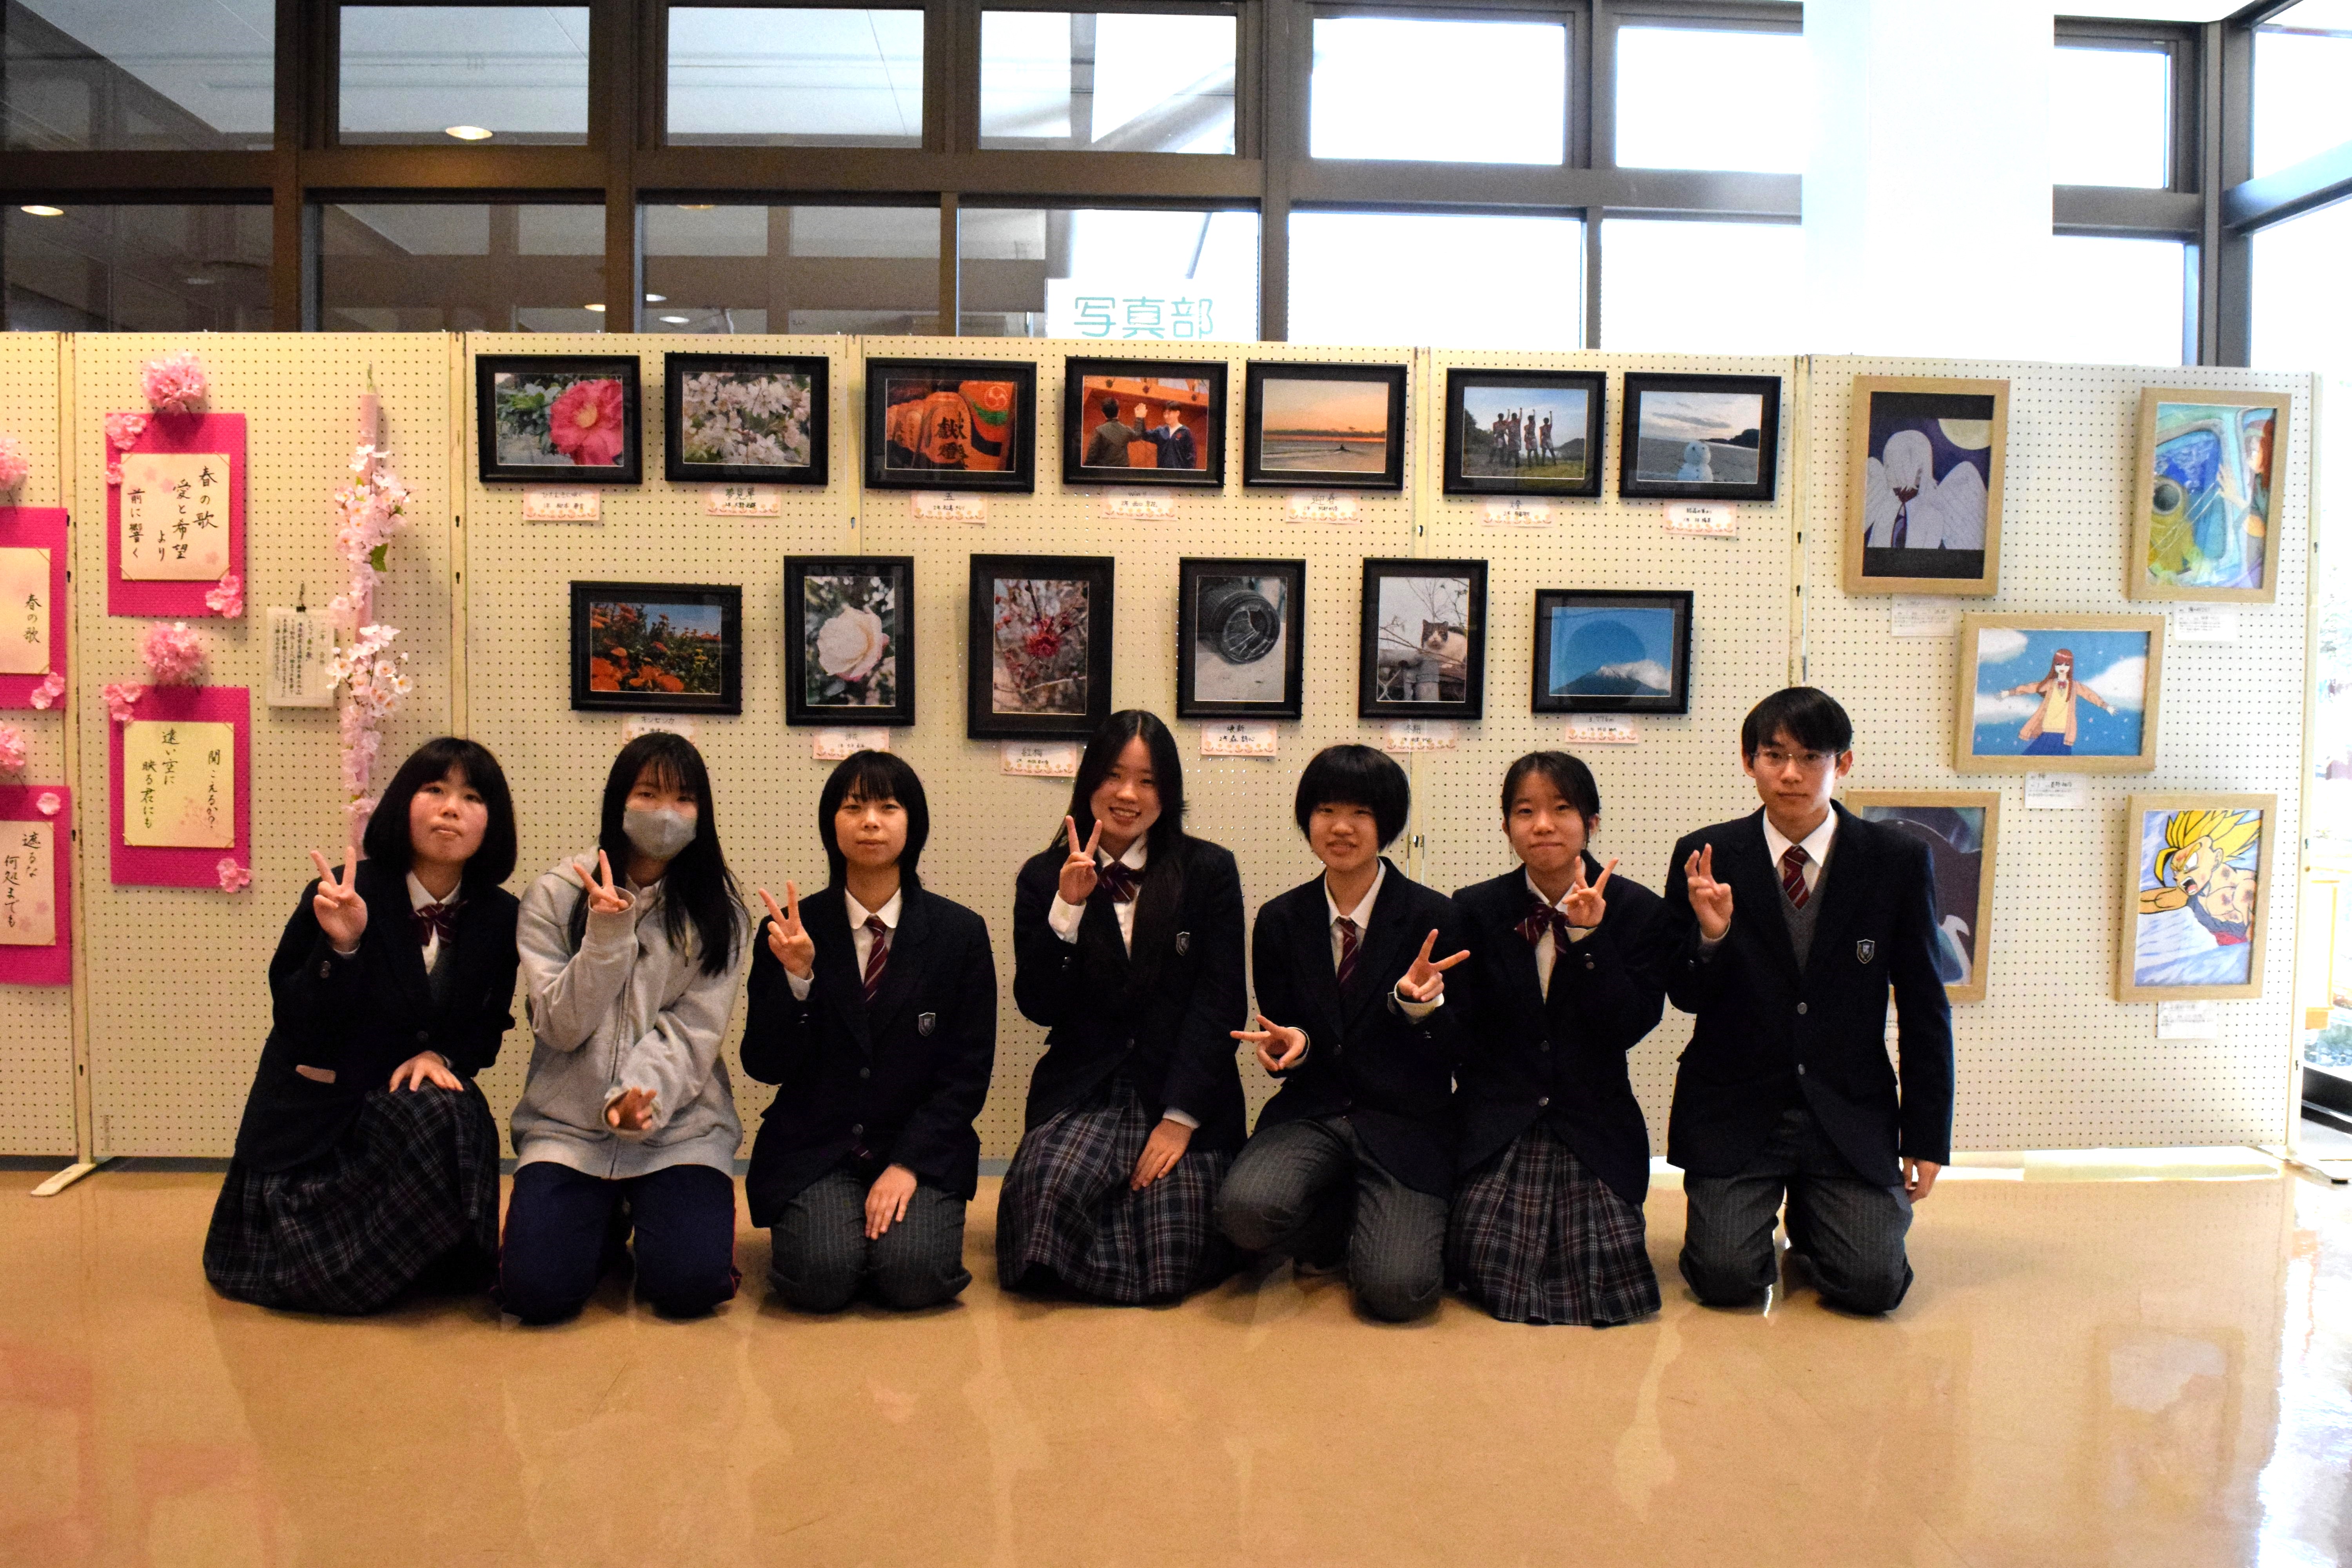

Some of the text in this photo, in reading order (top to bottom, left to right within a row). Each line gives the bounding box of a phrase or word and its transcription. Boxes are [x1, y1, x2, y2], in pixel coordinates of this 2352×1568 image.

[1074, 296, 1213, 339] 写真部
[127, 488, 145, 559] 前に響く
[172, 479, 191, 559] 愛と希望
[192, 465, 218, 529] 春の歌
[158, 530, 165, 562] より
[23, 593, 42, 643] 春の歌
[162, 728, 180, 785] 遠い空に
[141, 759, 157, 828] 映る君にも
[22, 831, 41, 878] 遮るな
[3, 855, 20, 928] 何処までも
